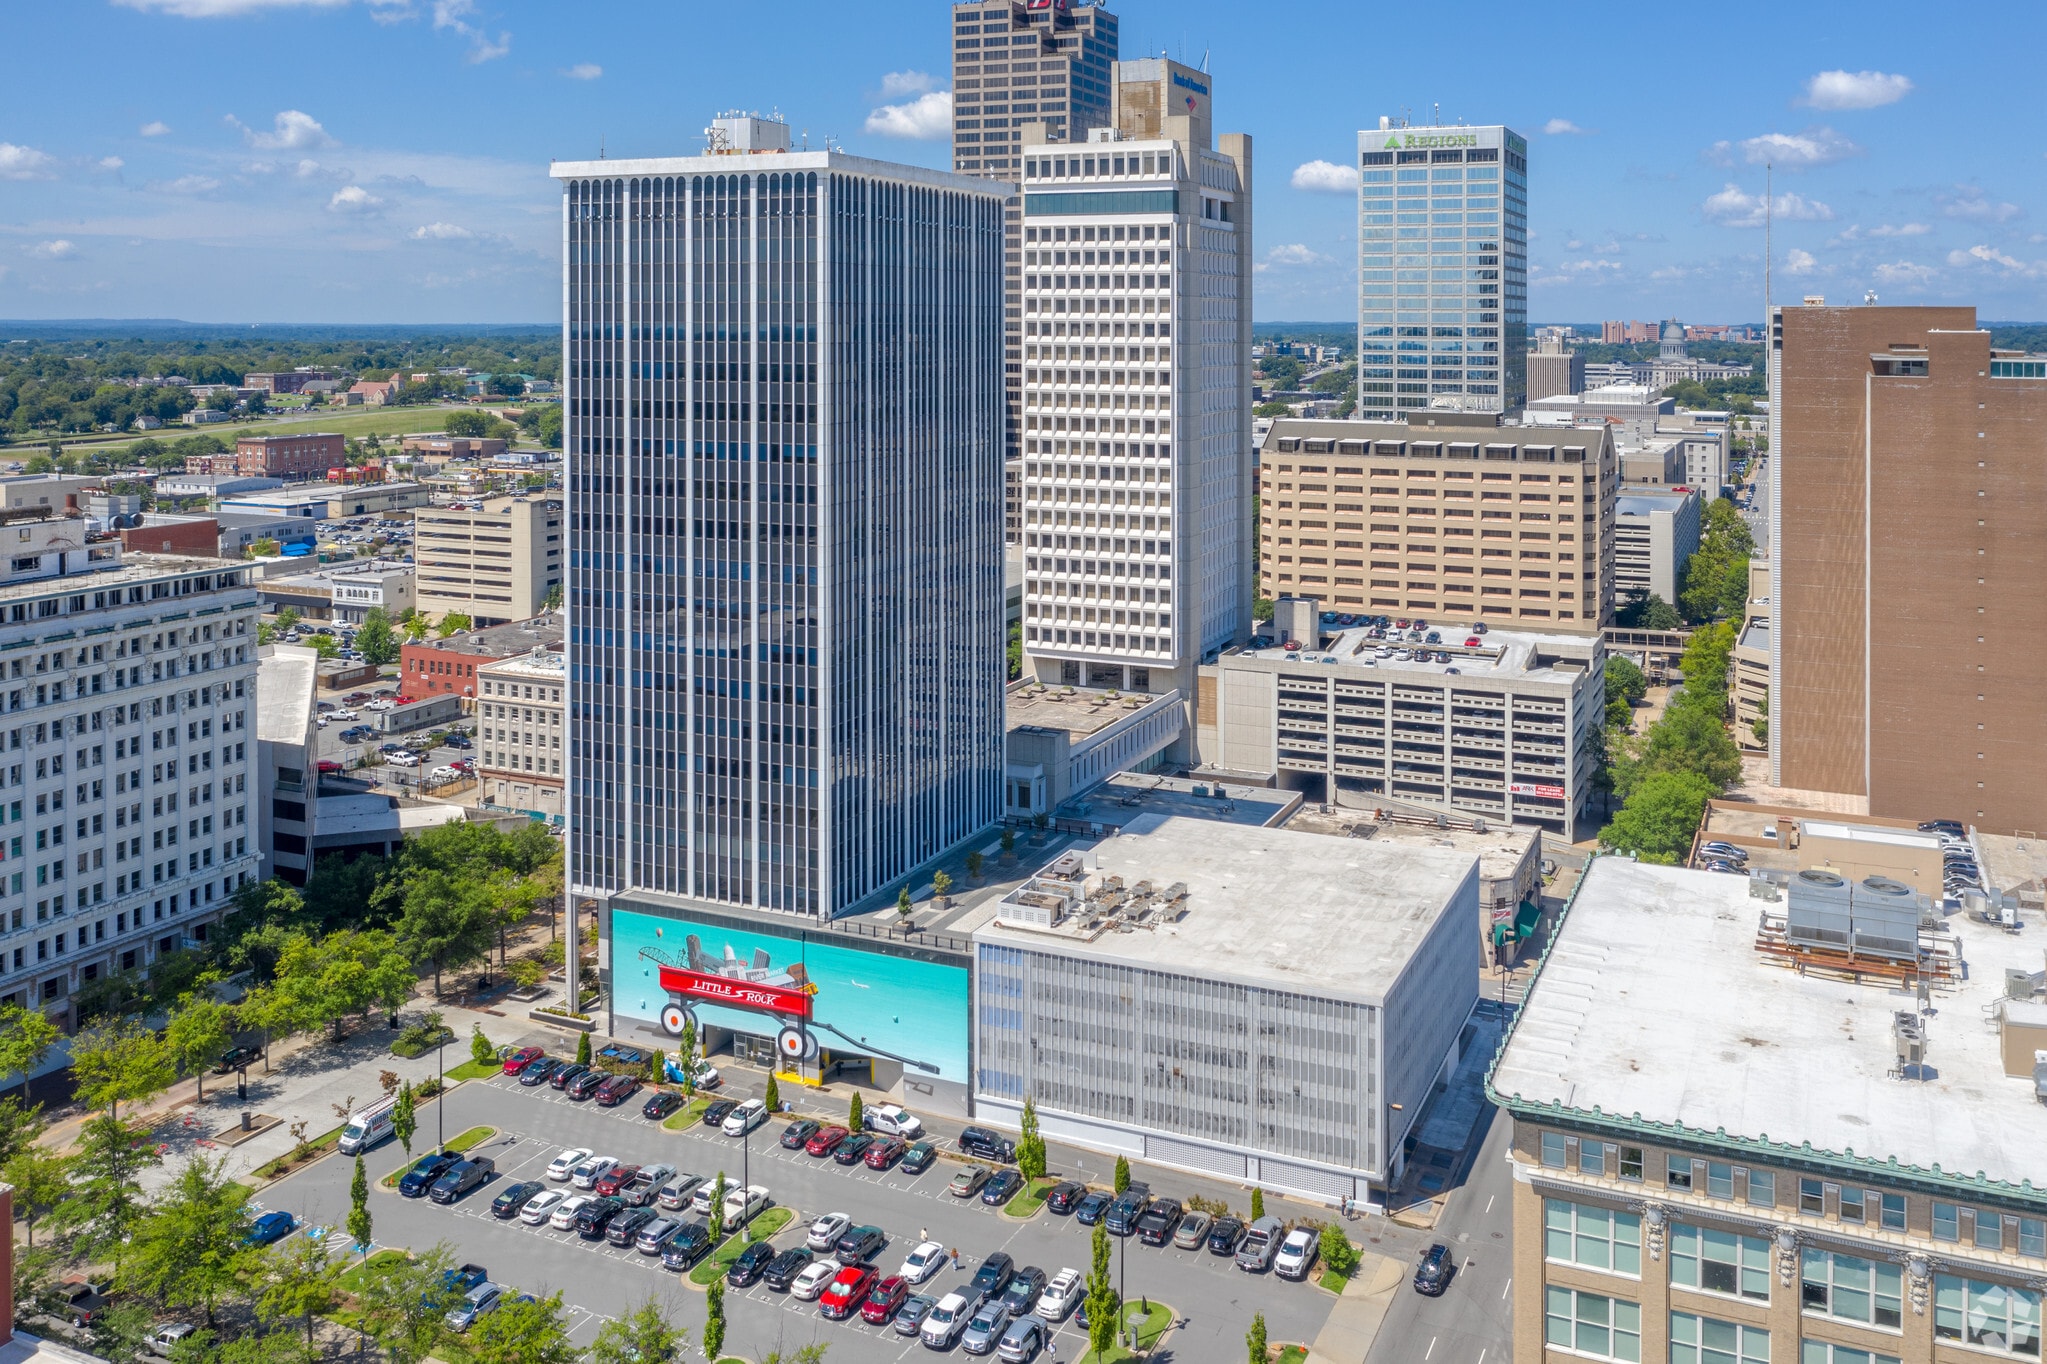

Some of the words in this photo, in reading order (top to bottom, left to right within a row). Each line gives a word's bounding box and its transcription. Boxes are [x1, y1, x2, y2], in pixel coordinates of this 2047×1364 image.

[1404, 133, 1477, 148] REGIONS
[693, 980, 732, 994] LITTLE
[746, 993, 777, 1006] ROCK
